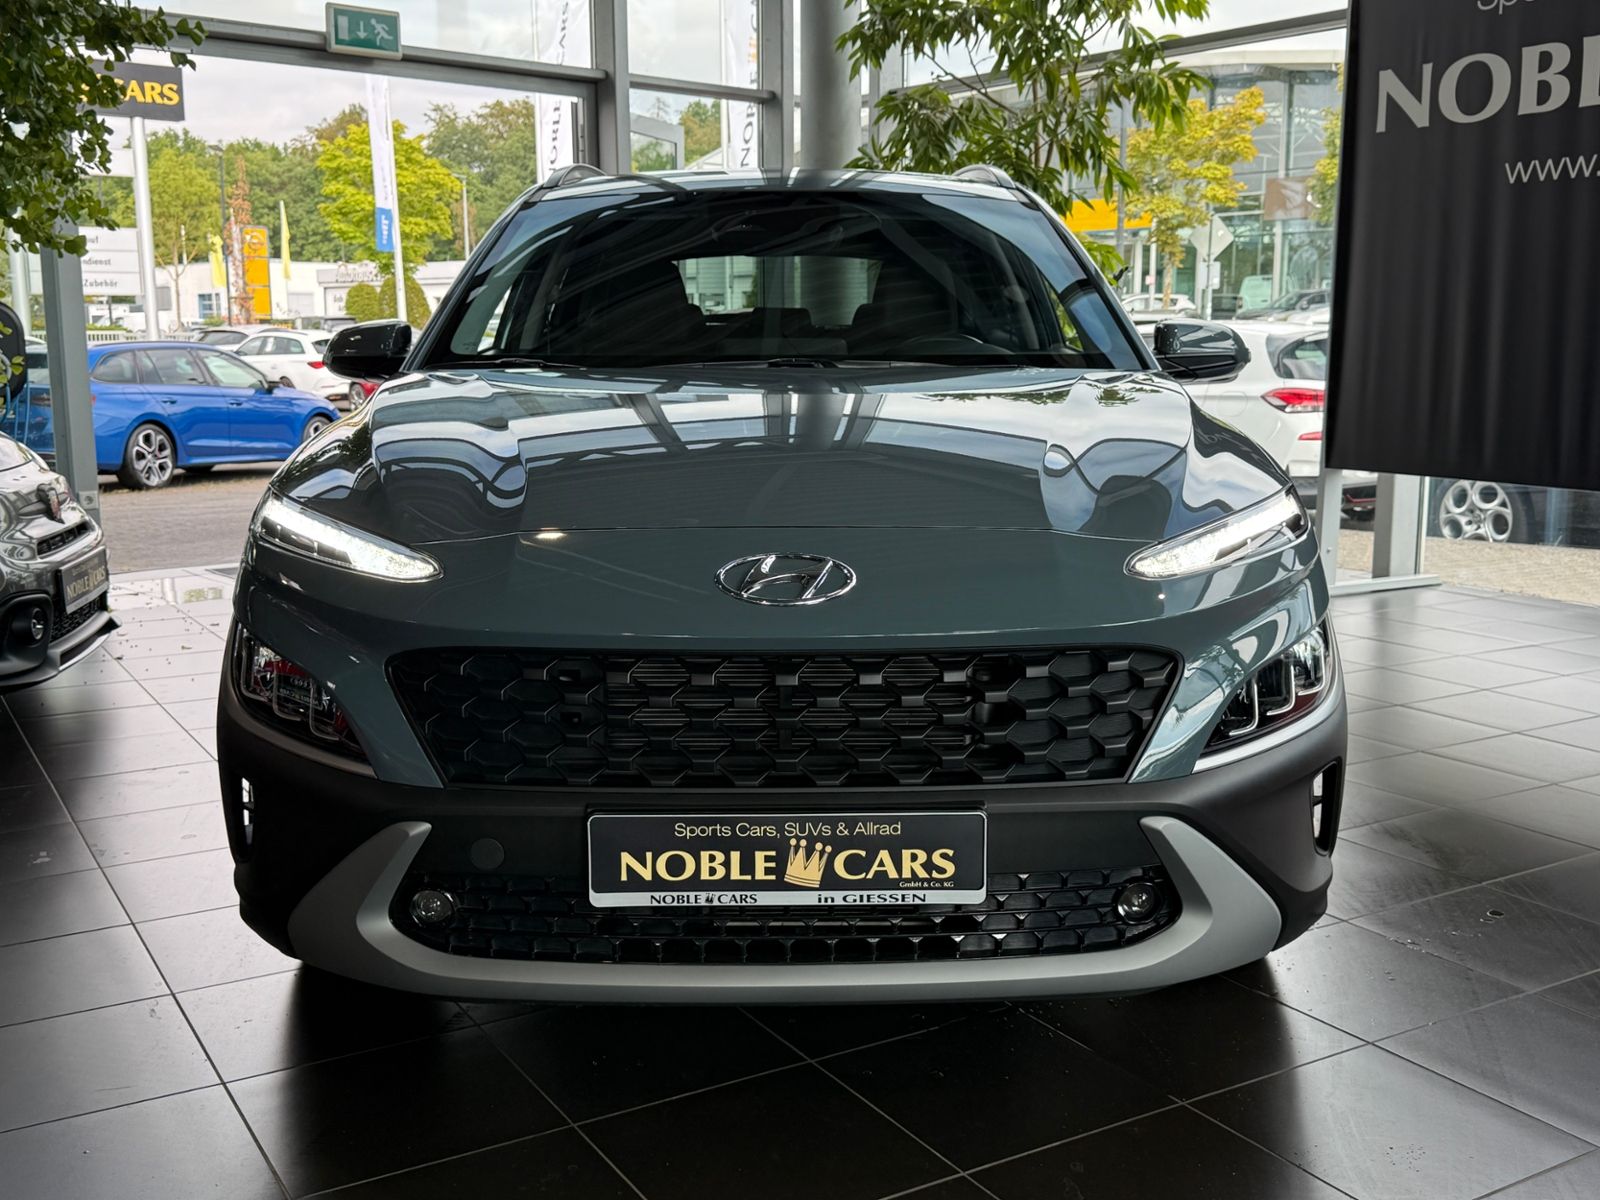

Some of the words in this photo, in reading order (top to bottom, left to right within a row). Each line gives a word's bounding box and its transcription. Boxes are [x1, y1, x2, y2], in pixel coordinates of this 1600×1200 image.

[113, 78, 180, 105] ARS
[674, 822, 731, 839] Sports
[736, 822, 780, 838] Cars,
[784, 822, 831, 836] SUVs
[836, 822, 850, 836] &
[853, 821, 901, 835] Allrad
[620, 850, 777, 881] NOBLE
[833, 848, 956, 880] CARS
[650, 894, 702, 905] NOBLE
[717, 893, 758, 904] CARS
[817, 893, 835, 904] in
[842, 893, 927, 903] GIESSEN
